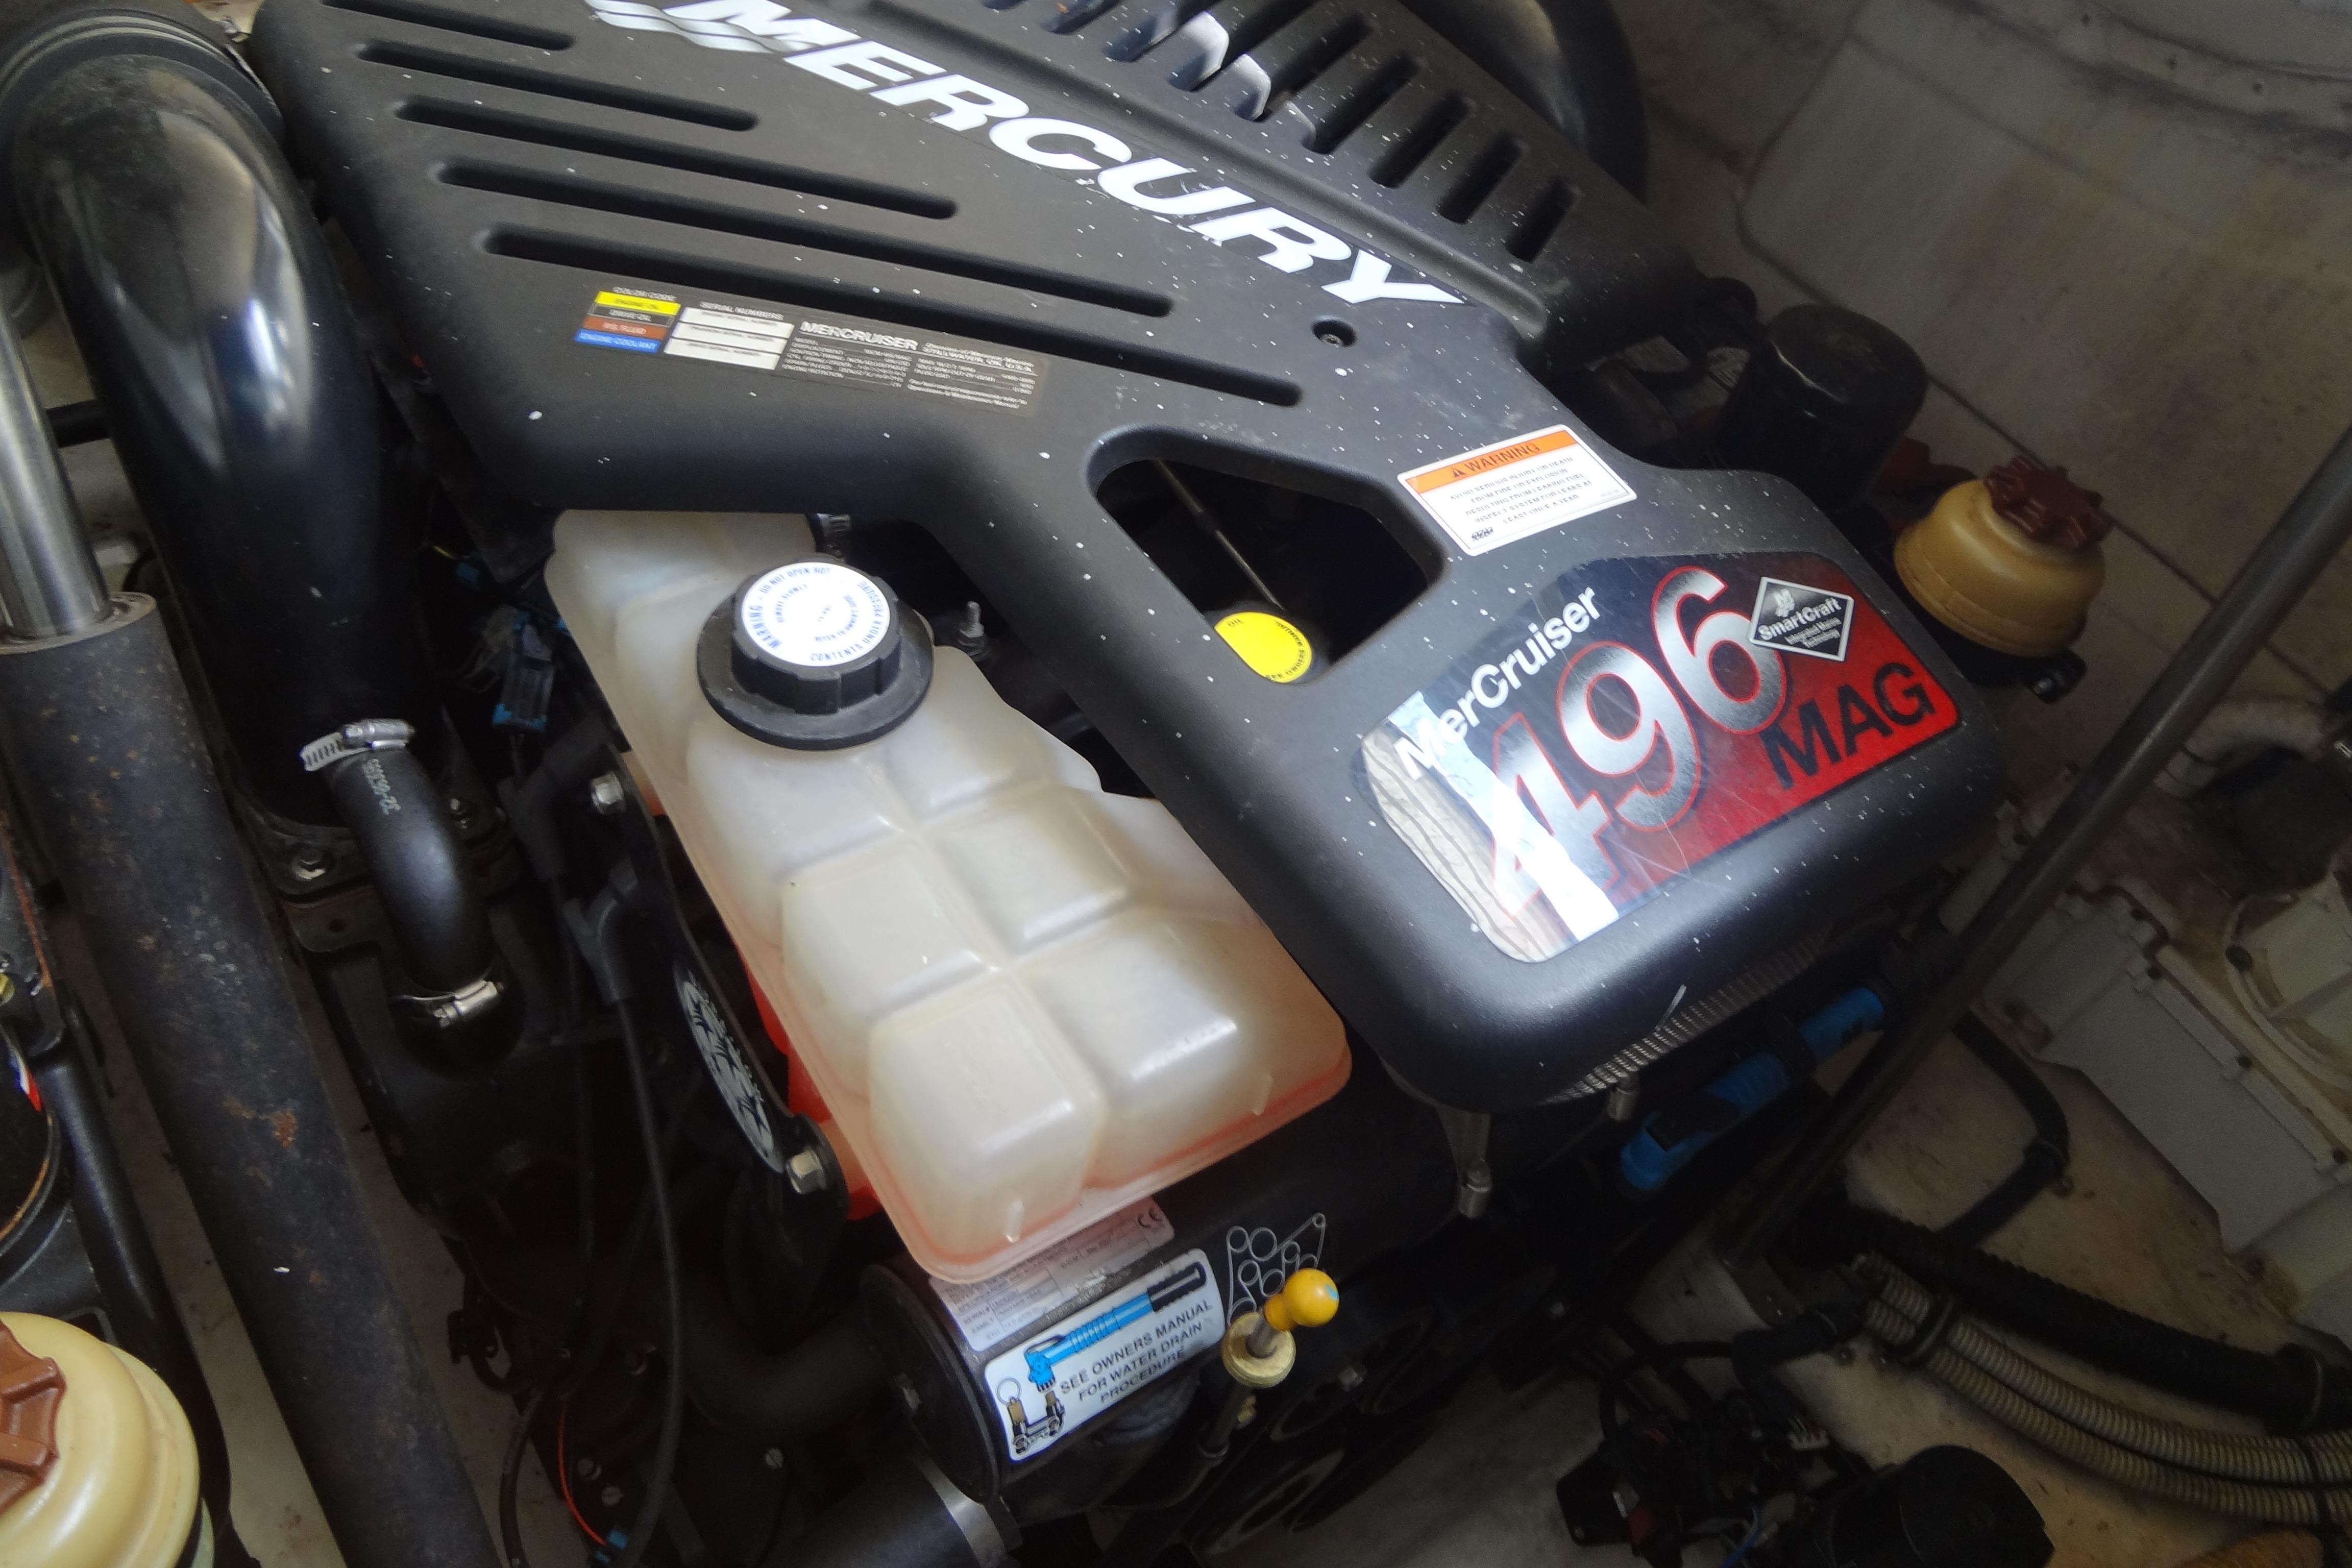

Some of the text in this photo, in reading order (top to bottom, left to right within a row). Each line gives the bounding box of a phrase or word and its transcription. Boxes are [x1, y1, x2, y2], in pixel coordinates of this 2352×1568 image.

[664, 0, 1468, 305] MERCURY
[800, 321, 918, 350] MERCRUISER
[1464, 443, 1541, 472] WARNING
[1758, 598, 1842, 641] SmartCraft
[1393, 585, 1605, 782] MerCruiser
[1760, 660, 1935, 790] MAG
[1490, 564, 1791, 924] 496
[1061, 1299, 1214, 1395] SEE OWNERS MANUAL
[1078, 1322, 1204, 1402] FOR WATER DRAIN
[1099, 1348, 1186, 1404] PROCEDURE
